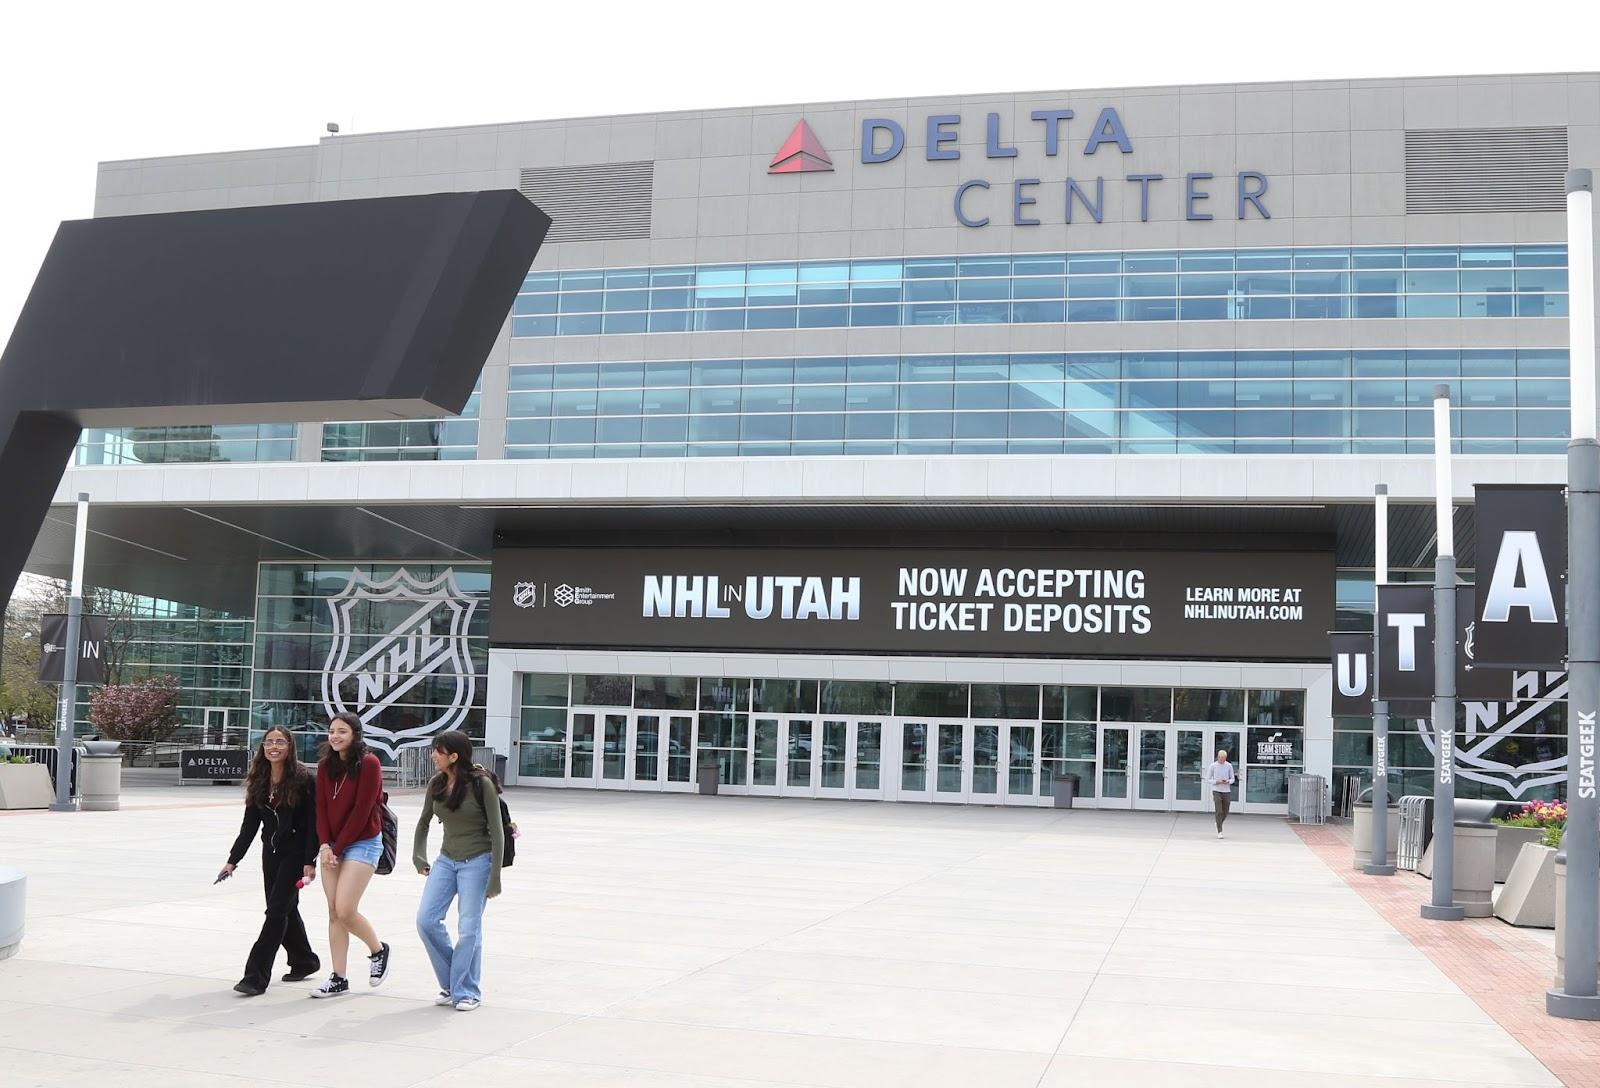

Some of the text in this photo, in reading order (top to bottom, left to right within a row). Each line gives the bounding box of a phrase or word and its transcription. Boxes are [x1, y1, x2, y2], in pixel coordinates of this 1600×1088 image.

[861, 107, 1133, 164] DELTA
[954, 171, 1271, 227] CENTER
[643, 575, 861, 620] NHL IN UTAH
[898, 568, 1145, 599] NOW ACCEPTING
[1186, 587, 1302, 603] LEARN MORE AT
[1481, 530, 1558, 623] A
[891, 602, 1151, 634] TICKET DEPOSITS
[1184, 604, 1303, 621] NHLINUTAH.COM
[83, 640, 99, 659] IN
[1387, 613, 1425, 671] T
[356, 617, 444, 713] NHL
[1337, 653, 1367, 697] U
[198, 758, 228, 766] DELTA
[1258, 744, 1292, 754] TEAM STORE
[1377, 736, 1387, 777] SEATGEEK
[1440, 729, 1453, 784] SEATGEEK
[1577, 710, 1597, 799] SEATGEEK
[208, 766, 242, 775] CENTER
